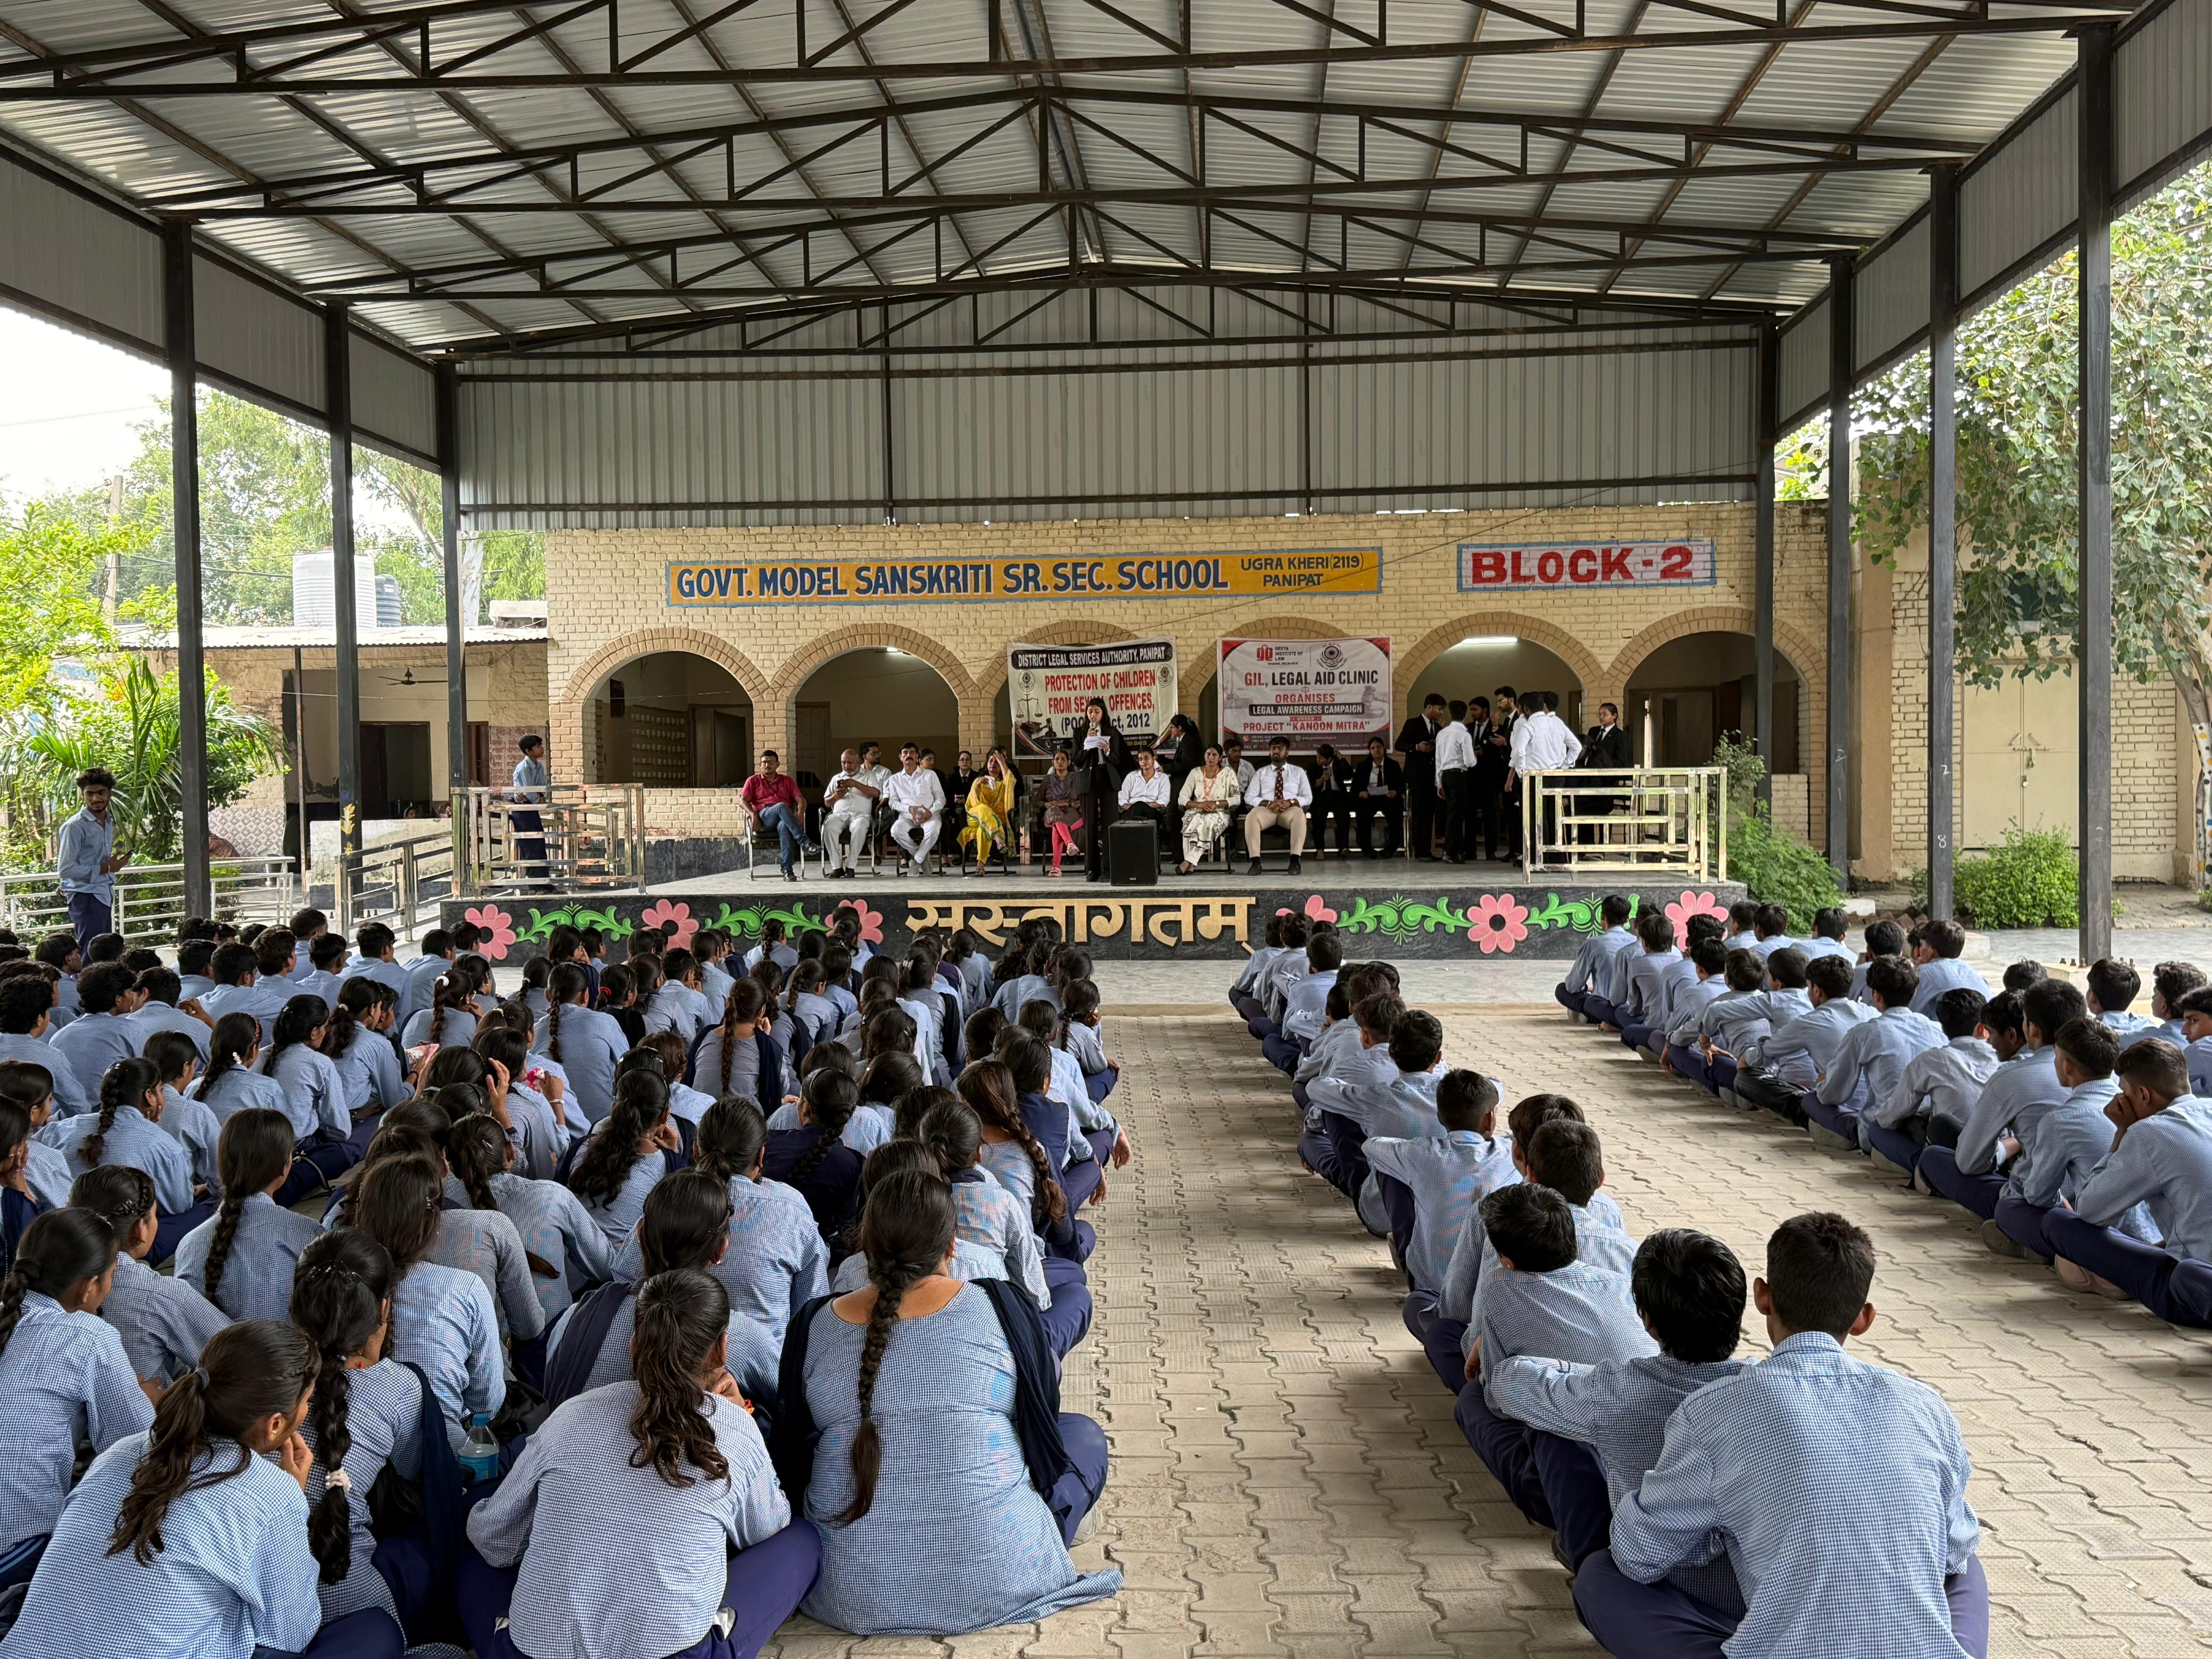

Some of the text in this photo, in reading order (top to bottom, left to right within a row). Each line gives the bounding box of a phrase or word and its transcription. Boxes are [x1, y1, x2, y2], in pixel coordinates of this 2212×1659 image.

[1241, 557, 1282, 571] UGRA
[1472, 546, 1693, 584] BLOCK-2
[677, 559, 1228, 598] GOVT. MODEL SANSKRITI SR. SEC. SCHOOL
[1263, 573, 1324, 588] PANIPAT
[1018, 646, 1166, 667] DISTRICT LEGAL SERVICES AUTHORITY, PANIPAT
[1045, 669, 1156, 692] PROTECTION OF CHILDREN
[1244, 670, 1378, 688] GIL, LEGAL AID CLINIC
[1048, 692, 1155, 715] FROM SEX OFFENCES,
[1275, 693, 1336, 703] ORGANISES
[1252, 704, 1362, 715] LEGAL AWARENESS CAMPAIGN
[1110, 716, 1124, 731] ct,
[1127, 713, 1150, 728] 2012
[1243, 723, 1283, 732] PROJECT
